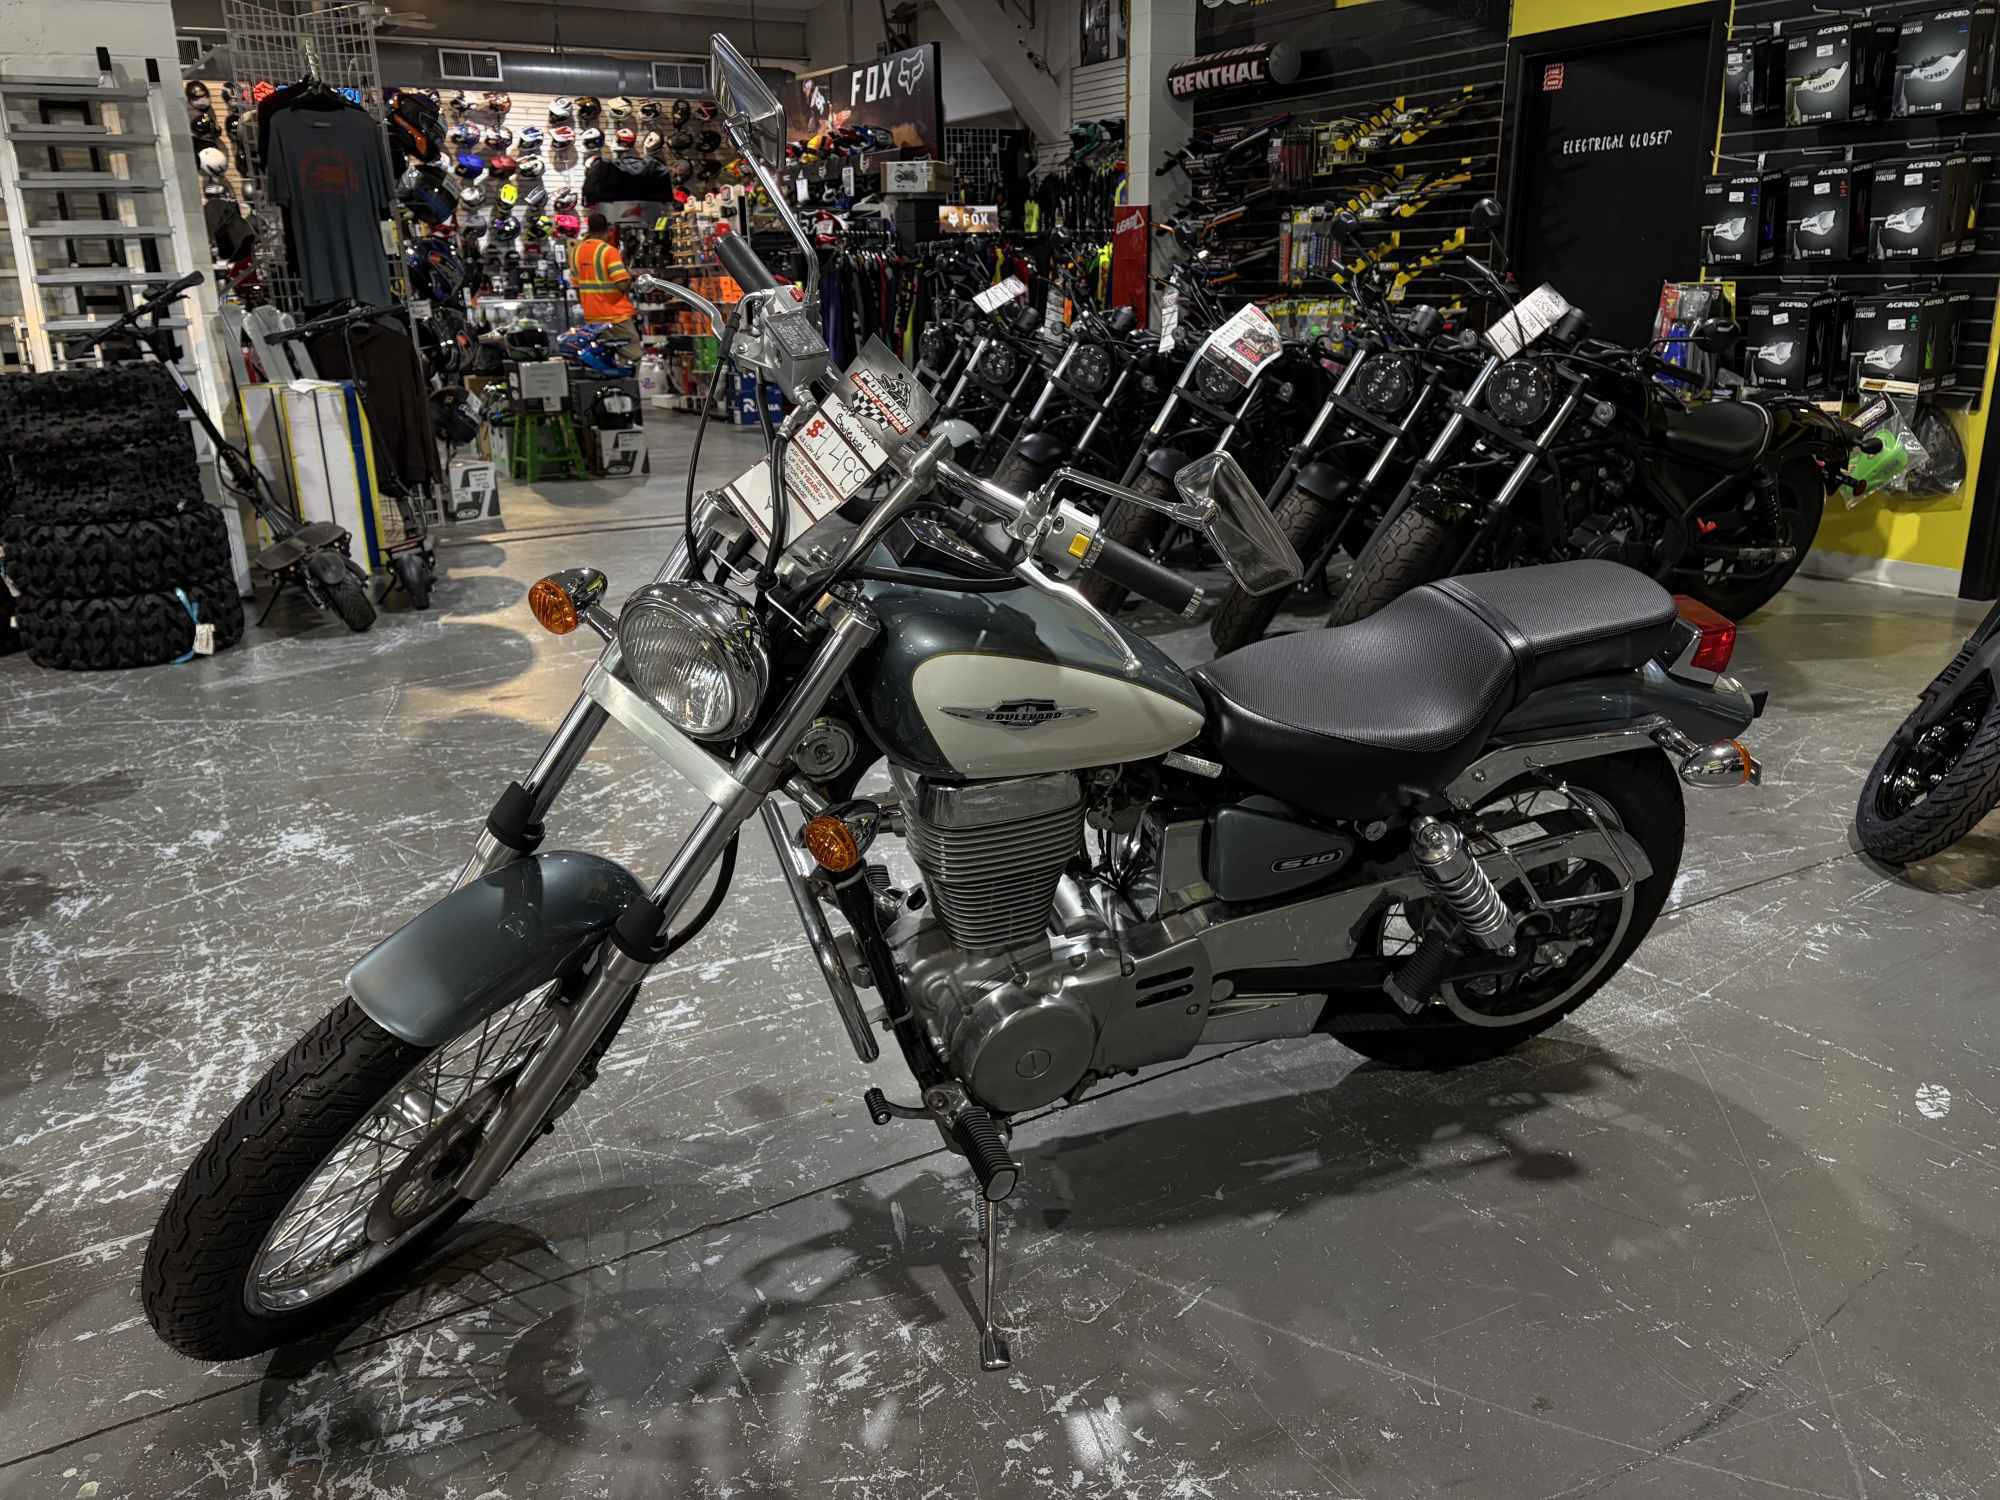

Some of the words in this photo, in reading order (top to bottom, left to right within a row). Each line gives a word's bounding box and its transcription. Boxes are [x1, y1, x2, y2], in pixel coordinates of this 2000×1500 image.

[851, 60, 894, 107] FOX
[1172, 60, 1264, 95] RENTHAL
[1562, 134, 1623, 154] ELECTRICAL
[1629, 130, 1672, 149] CLOSET
[962, 213, 988, 226] FOX
[852, 374, 878, 404] SPORT
[876, 402, 906, 433] CENTER
[858, 369, 914, 429] POMPION
[802, 473, 821, 494] YEARS
[985, 712, 1062, 721] BOULEVARD
